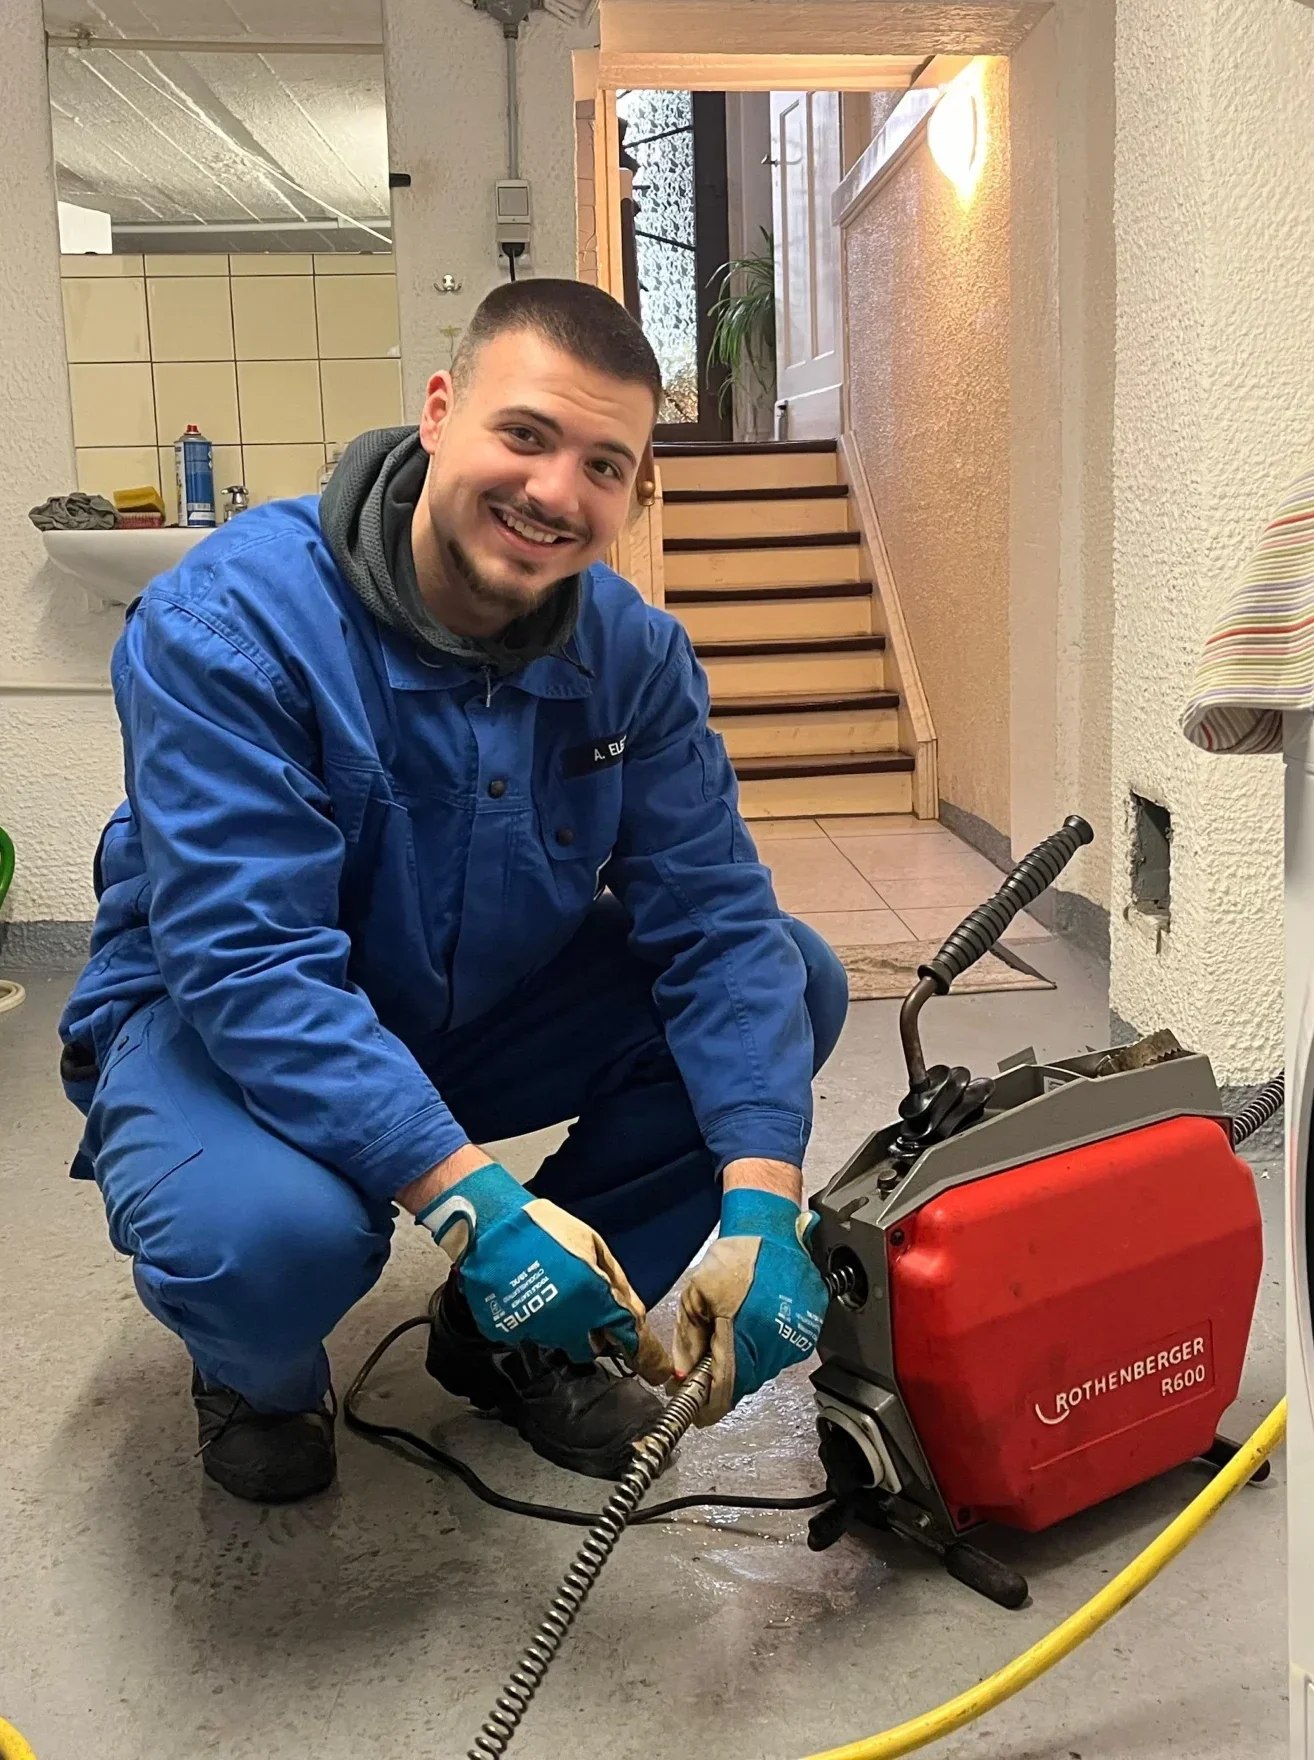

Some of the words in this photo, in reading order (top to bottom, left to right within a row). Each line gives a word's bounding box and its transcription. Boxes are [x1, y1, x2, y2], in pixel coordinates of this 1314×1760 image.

[594, 748, 605, 761] A.
[496, 1283, 558, 1331] CONEL
[775, 1318, 812, 1352] CONEL
[1056, 1337, 1204, 1413] ROTHENBERGER
[1161, 1364, 1205, 1396] R600
